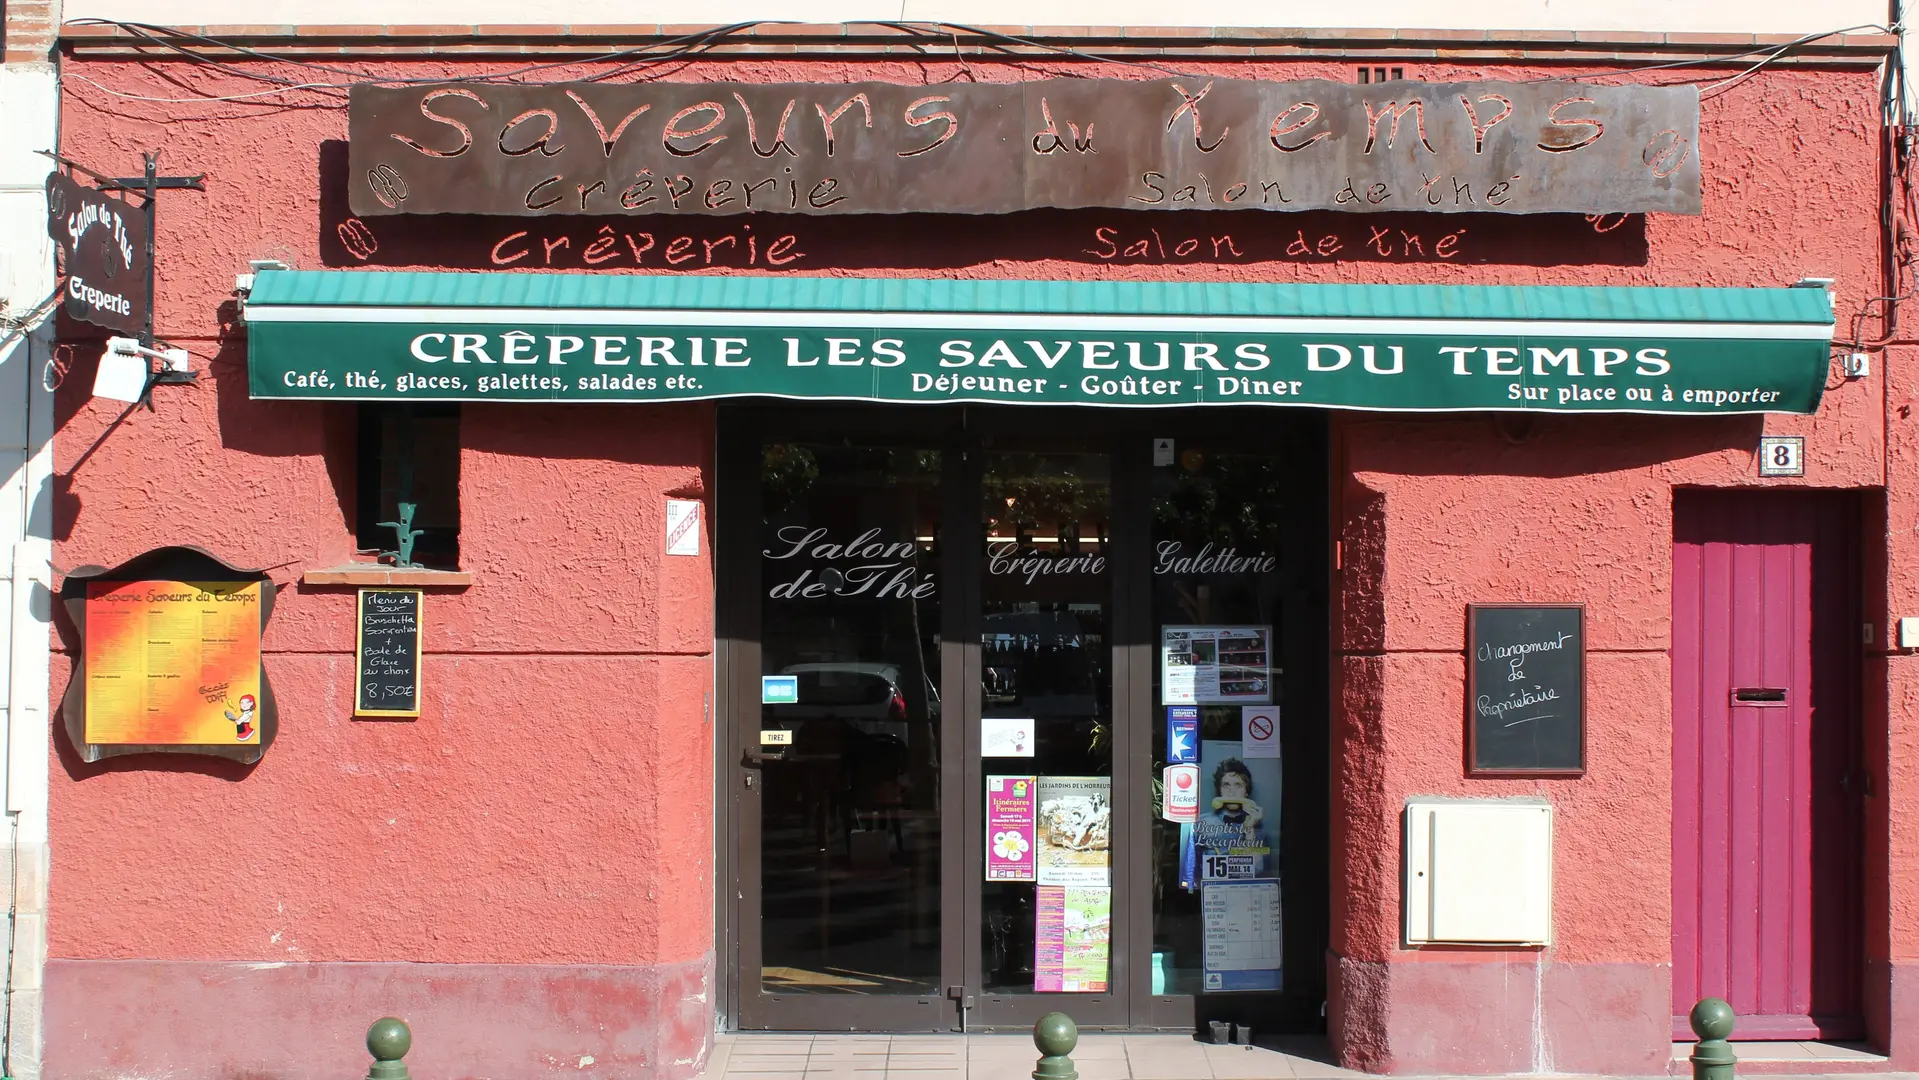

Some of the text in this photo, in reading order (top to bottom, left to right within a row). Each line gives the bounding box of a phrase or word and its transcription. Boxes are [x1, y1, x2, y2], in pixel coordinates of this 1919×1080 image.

[391, 87, 957, 158] Saveurs
[1031, 97, 1098, 155] du
[1128, 171, 1520, 206] Salon de thé
[68, 201, 134, 270] Salon de Thé
[69, 276, 130, 316] Creperie
[410, 330, 1672, 377] CRÊPERIE LES SAVEURS DU TEMPS
[284, 370, 704, 393] Café, thé, glaces, galettes, salades etc.
[912, 372, 1047, 396] Déjeuner
[1081, 375, 1182, 396] Goûter
[1219, 377, 1302, 396] Dîner
[1508, 383, 1780, 404] Sur place ou à emporter
[1774, 445, 1790, 465] 8
[762, 526, 918, 559] Salon
[987, 541, 1105, 585] Crêperie
[1153, 540, 1276, 574] Galetterie
[769, 562, 936, 599] de Thé
[196, 589, 210, 602] du
[368, 594, 414, 605] Menu du
[395, 645, 407, 655] de
[993, 798, 1029, 806] Itinéraires
[996, 804, 1027, 812] Fermiers
[1194, 820, 1252, 837] Baptiste
[1206, 856, 1227, 878] 15
